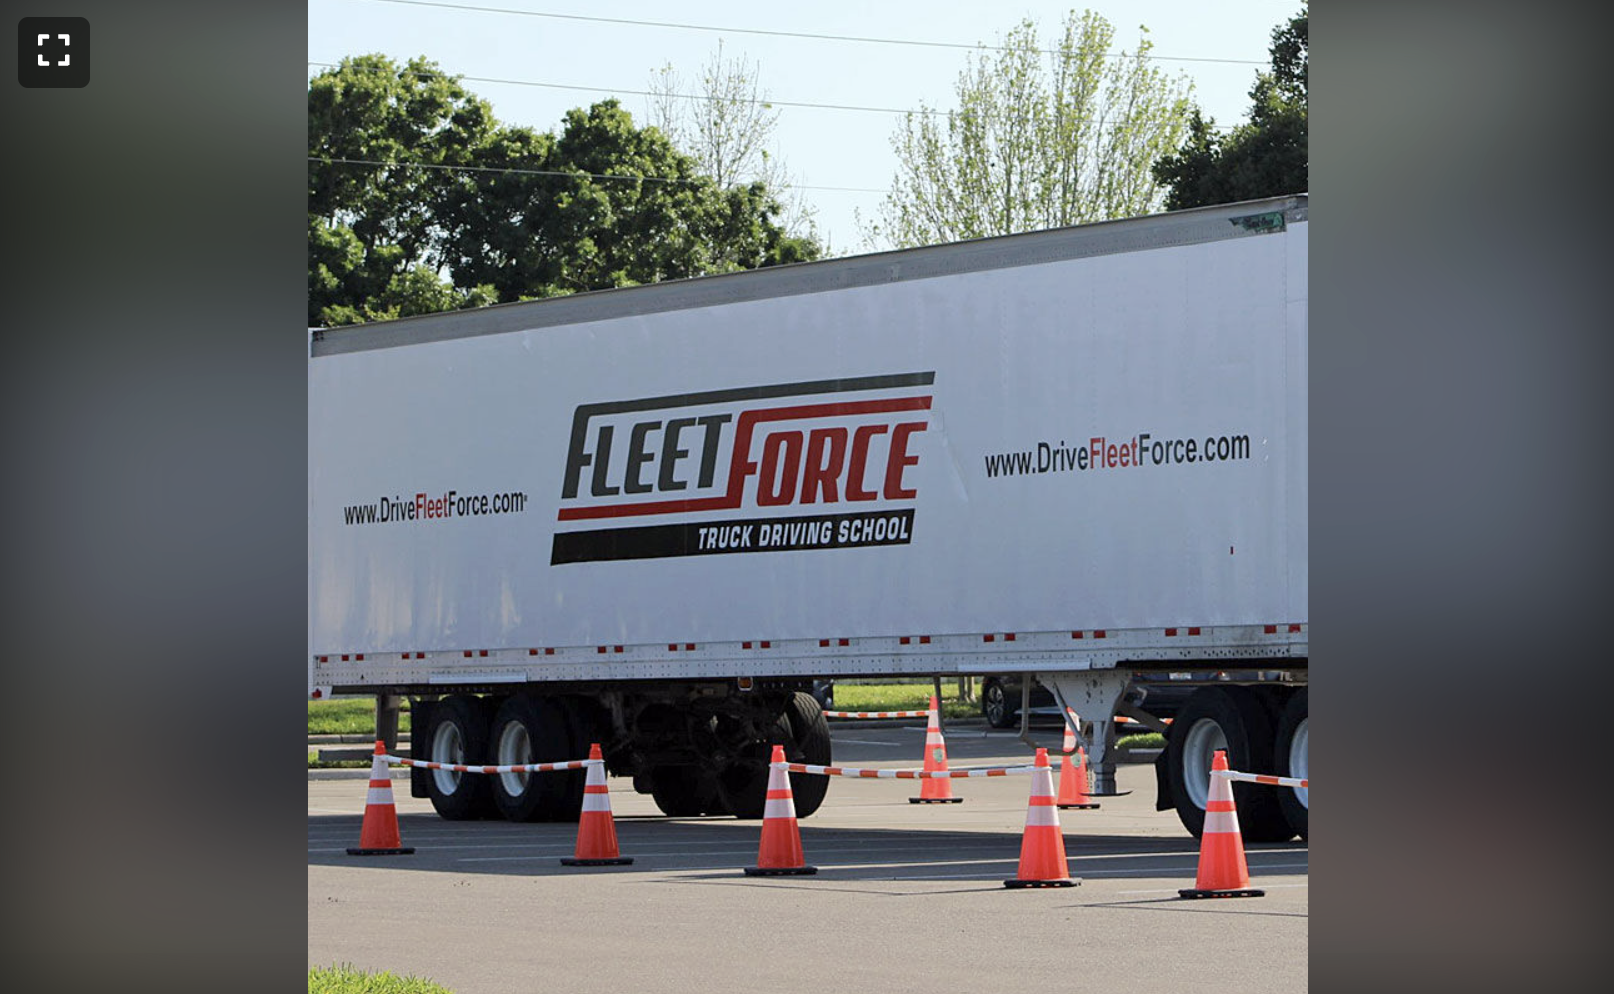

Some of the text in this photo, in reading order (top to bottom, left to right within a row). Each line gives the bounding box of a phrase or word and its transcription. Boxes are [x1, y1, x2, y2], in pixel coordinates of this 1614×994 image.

[985, 433, 1250, 478] www.DriveFleetForce.com
[344, 490, 524, 525] www.DriveFleetForce.com
[698, 516, 909, 550] TRUCK DRIVING SCHOOL
